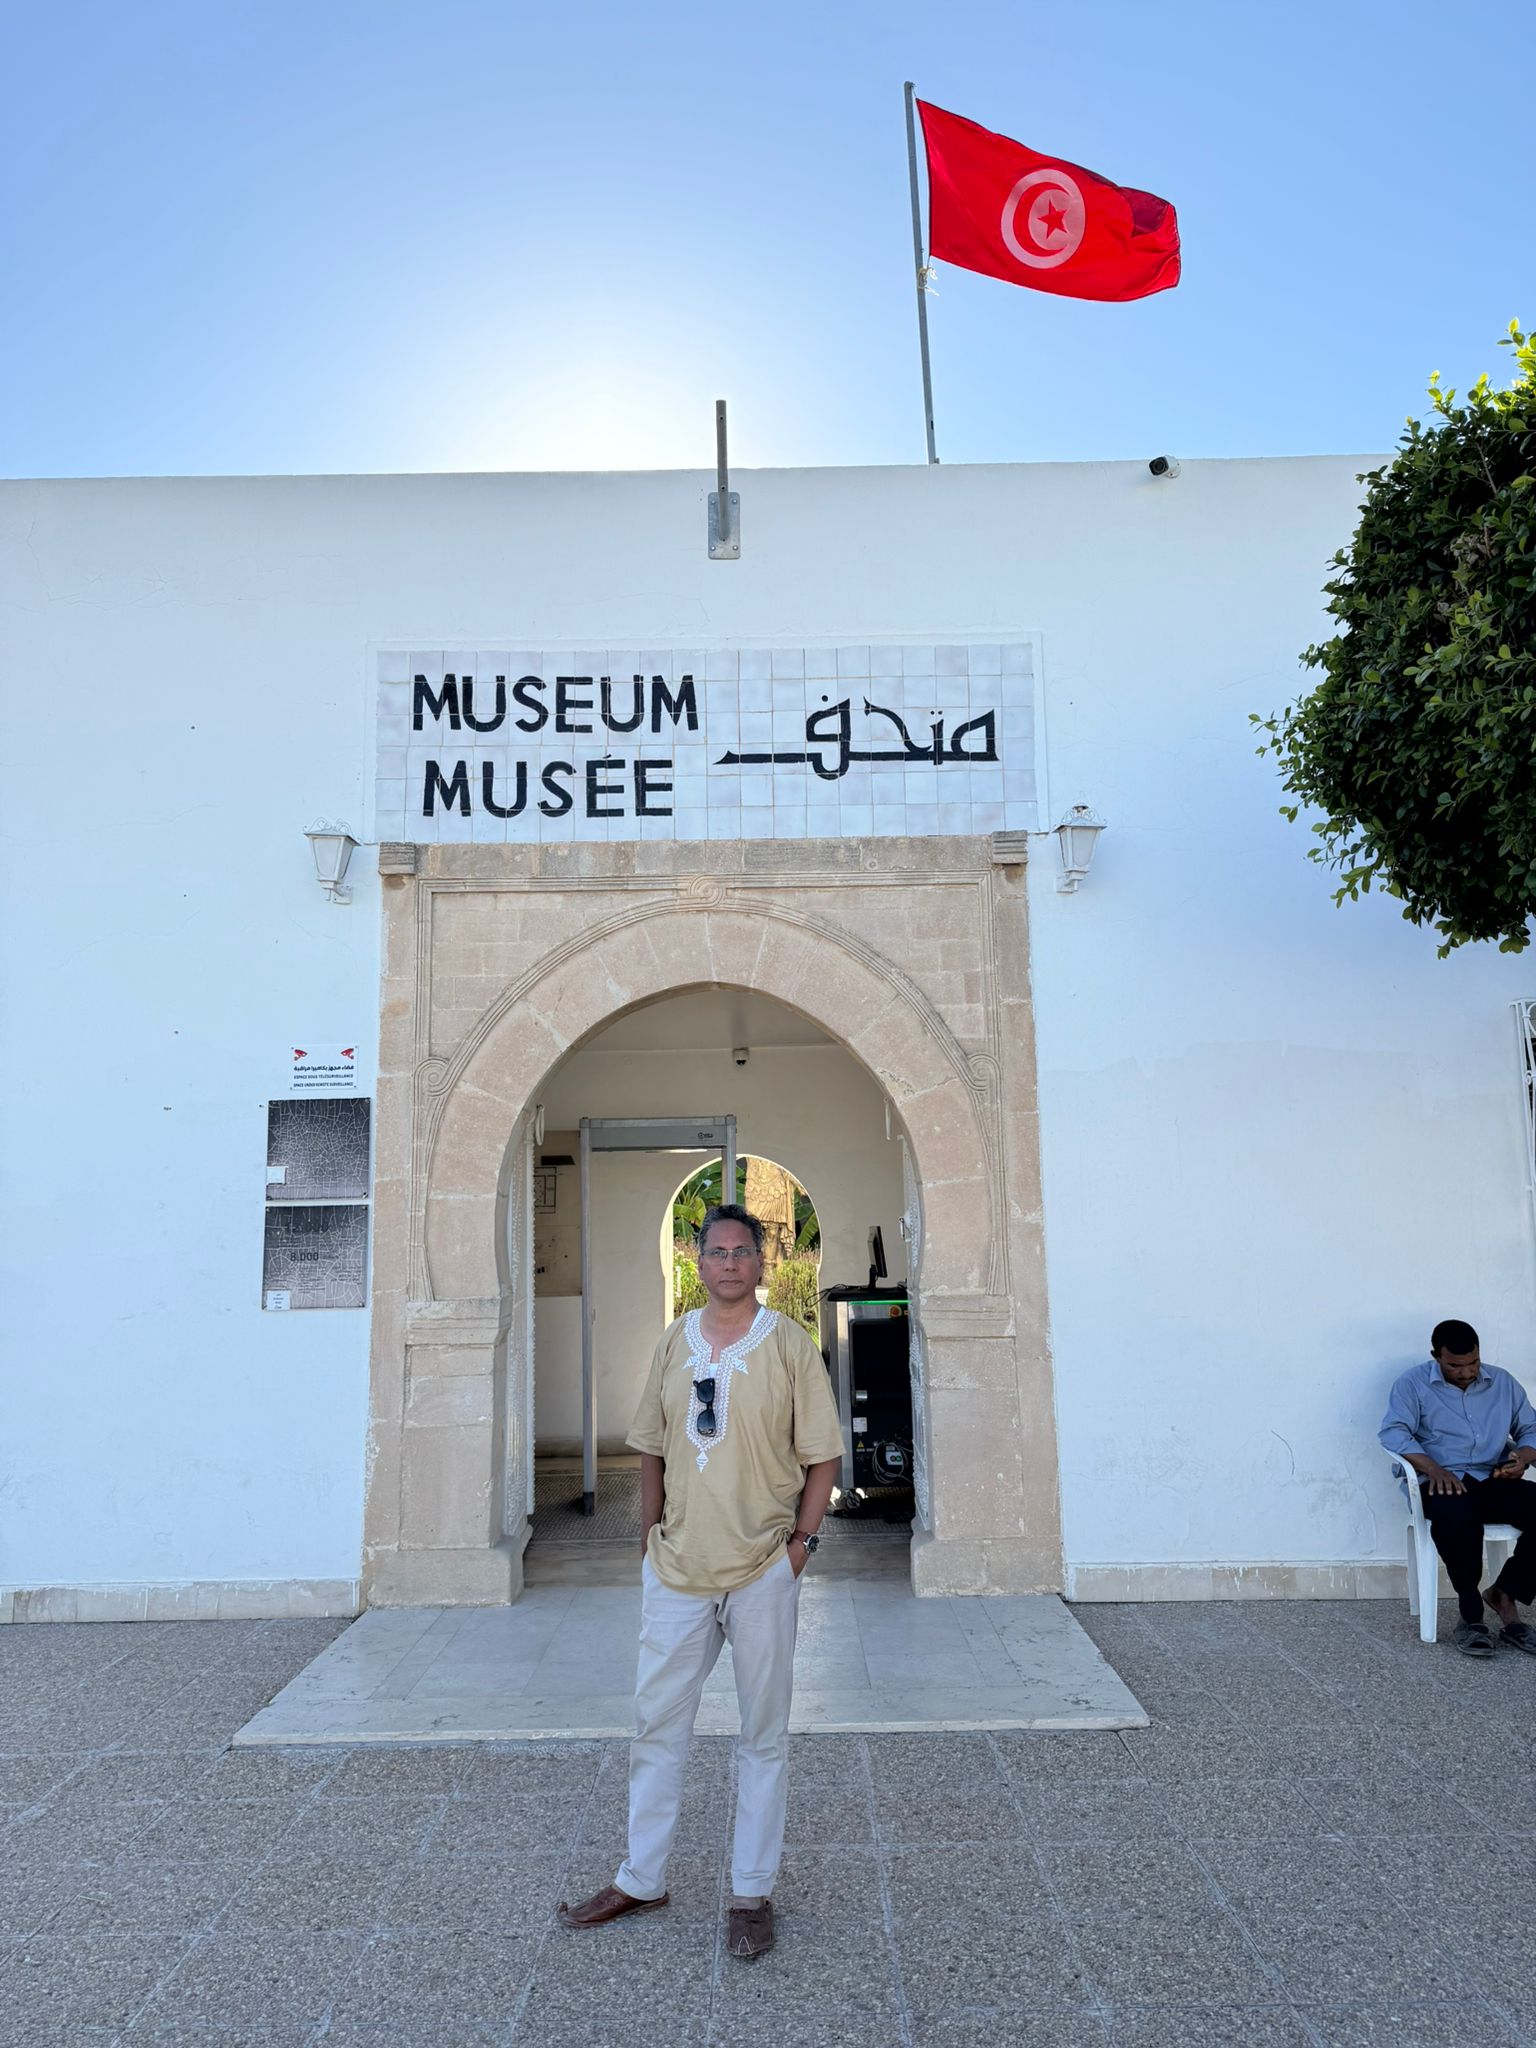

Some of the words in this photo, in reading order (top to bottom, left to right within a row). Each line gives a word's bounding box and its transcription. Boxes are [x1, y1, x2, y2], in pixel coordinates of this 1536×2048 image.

[413, 674, 699, 733] MUSEUM
[714, 694, 1000, 781] متحف
[422, 754, 673, 818] MUSÉE
